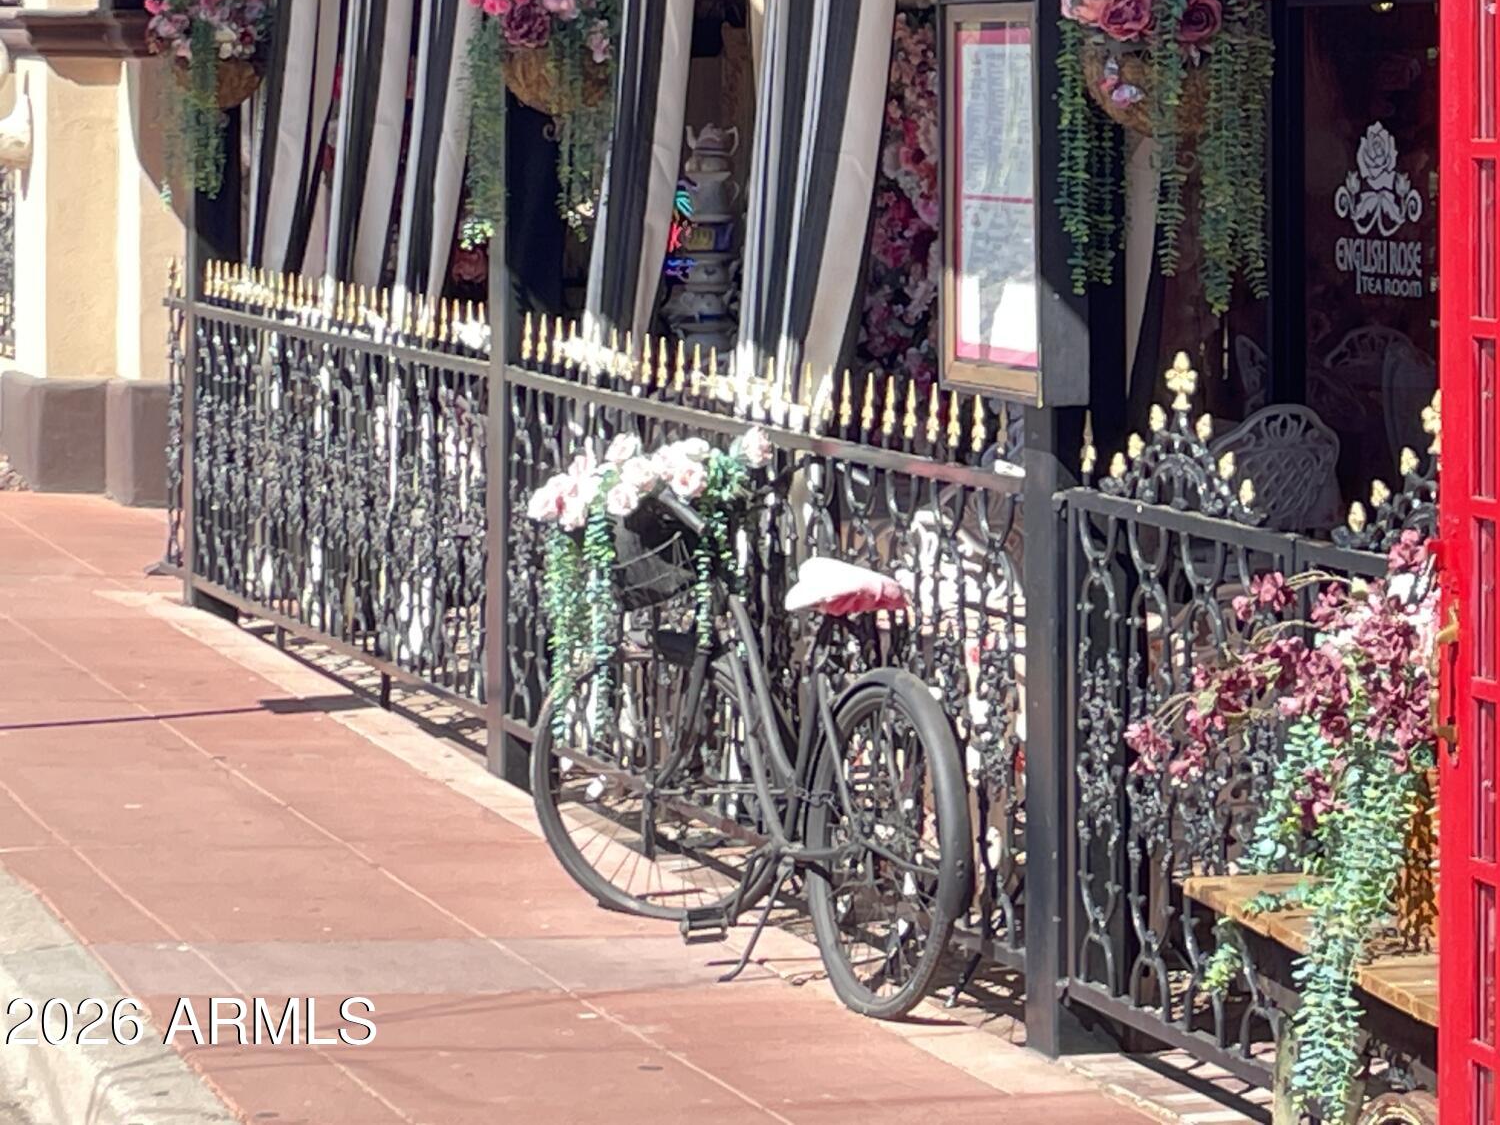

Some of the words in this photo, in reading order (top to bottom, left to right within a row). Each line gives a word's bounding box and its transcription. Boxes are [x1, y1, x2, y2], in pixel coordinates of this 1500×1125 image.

[1335, 237, 1387, 295] ENGLISH
[1389, 240, 1423, 278] ROSE
[1361, 277, 1382, 295] TEA
